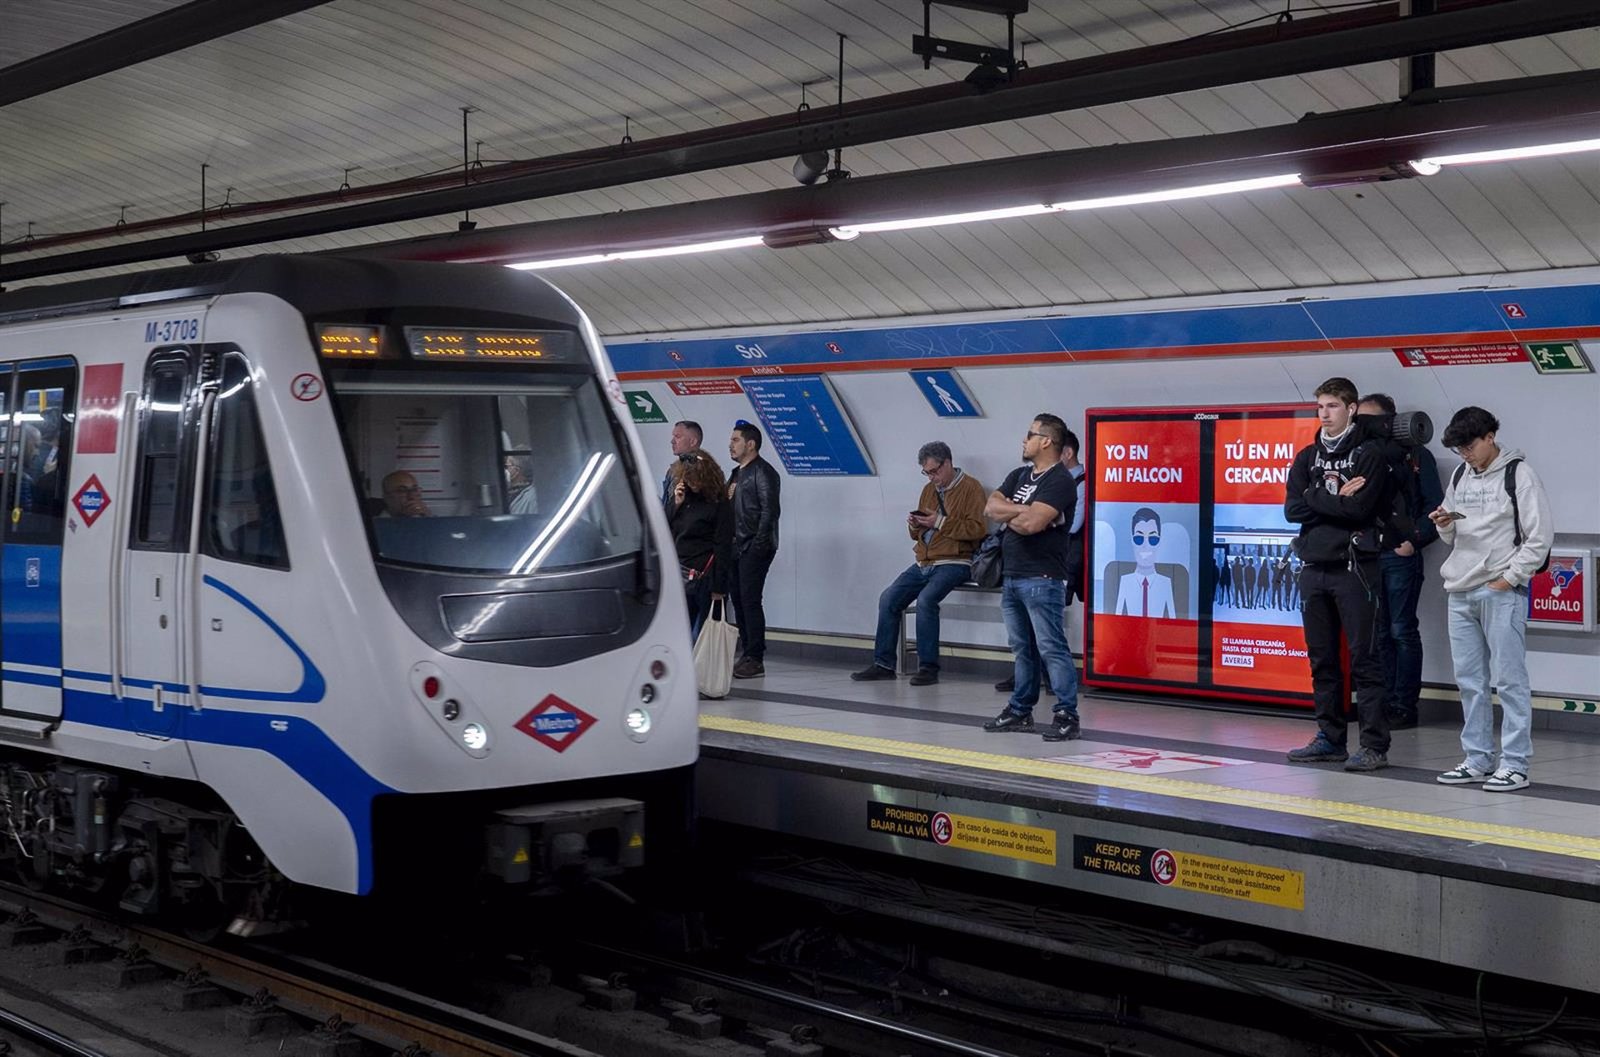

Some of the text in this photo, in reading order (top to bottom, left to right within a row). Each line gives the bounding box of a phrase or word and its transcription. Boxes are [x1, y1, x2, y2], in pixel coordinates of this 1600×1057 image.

[1507, 305, 1522, 317] 2
[144, 318, 198, 343] M-3708
[735, 343, 768, 359] Sol
[830, 343, 840, 353] 2
[751, 366, 784, 376] Andén 2
[1104, 445, 1148, 460] YO EN
[1224, 439, 1294, 460] TÚ EN MI
[1104, 467, 1183, 483] MI FALCON
[1224, 462, 1290, 483] CERCANÍ
[1533, 596, 1581, 612] CUÍDALO
[1229, 638, 1255, 646] LLAMABA
[1255, 639, 1286, 648] CERCANÍAS
[1240, 646, 1252, 654] QUE
[1260, 648, 1287, 656] ENCARGÓ
[1224, 655, 1252, 666] AVERÍAS
[536, 717, 575, 731] Metro
[885, 807, 928, 824] PROHIBIDO
[870, 818, 928, 838] BAJAR A LA VÍA
[957, 820, 965, 830] En
[966, 824, 981, 833] caso
[982, 824, 990, 834] de
[1010, 830, 1018, 839] de
[1019, 831, 1046, 845] objetos,
[987, 838, 1015, 851] personal
[1015, 843, 1024, 851] de
[1025, 844, 1053, 856] estación
[1095, 842, 1142, 860] KEEP OFF
[1083, 855, 1141, 876] THE TRACKS
[1182, 856, 1284, 882] In the event of objects dropped
[1181, 879, 1251, 898] from the station staff
[1191, 869, 1202, 879] the
[1203, 871, 1225, 884] tracks,
[1227, 876, 1242, 887] seek
[1244, 880, 1281, 892] assistance
